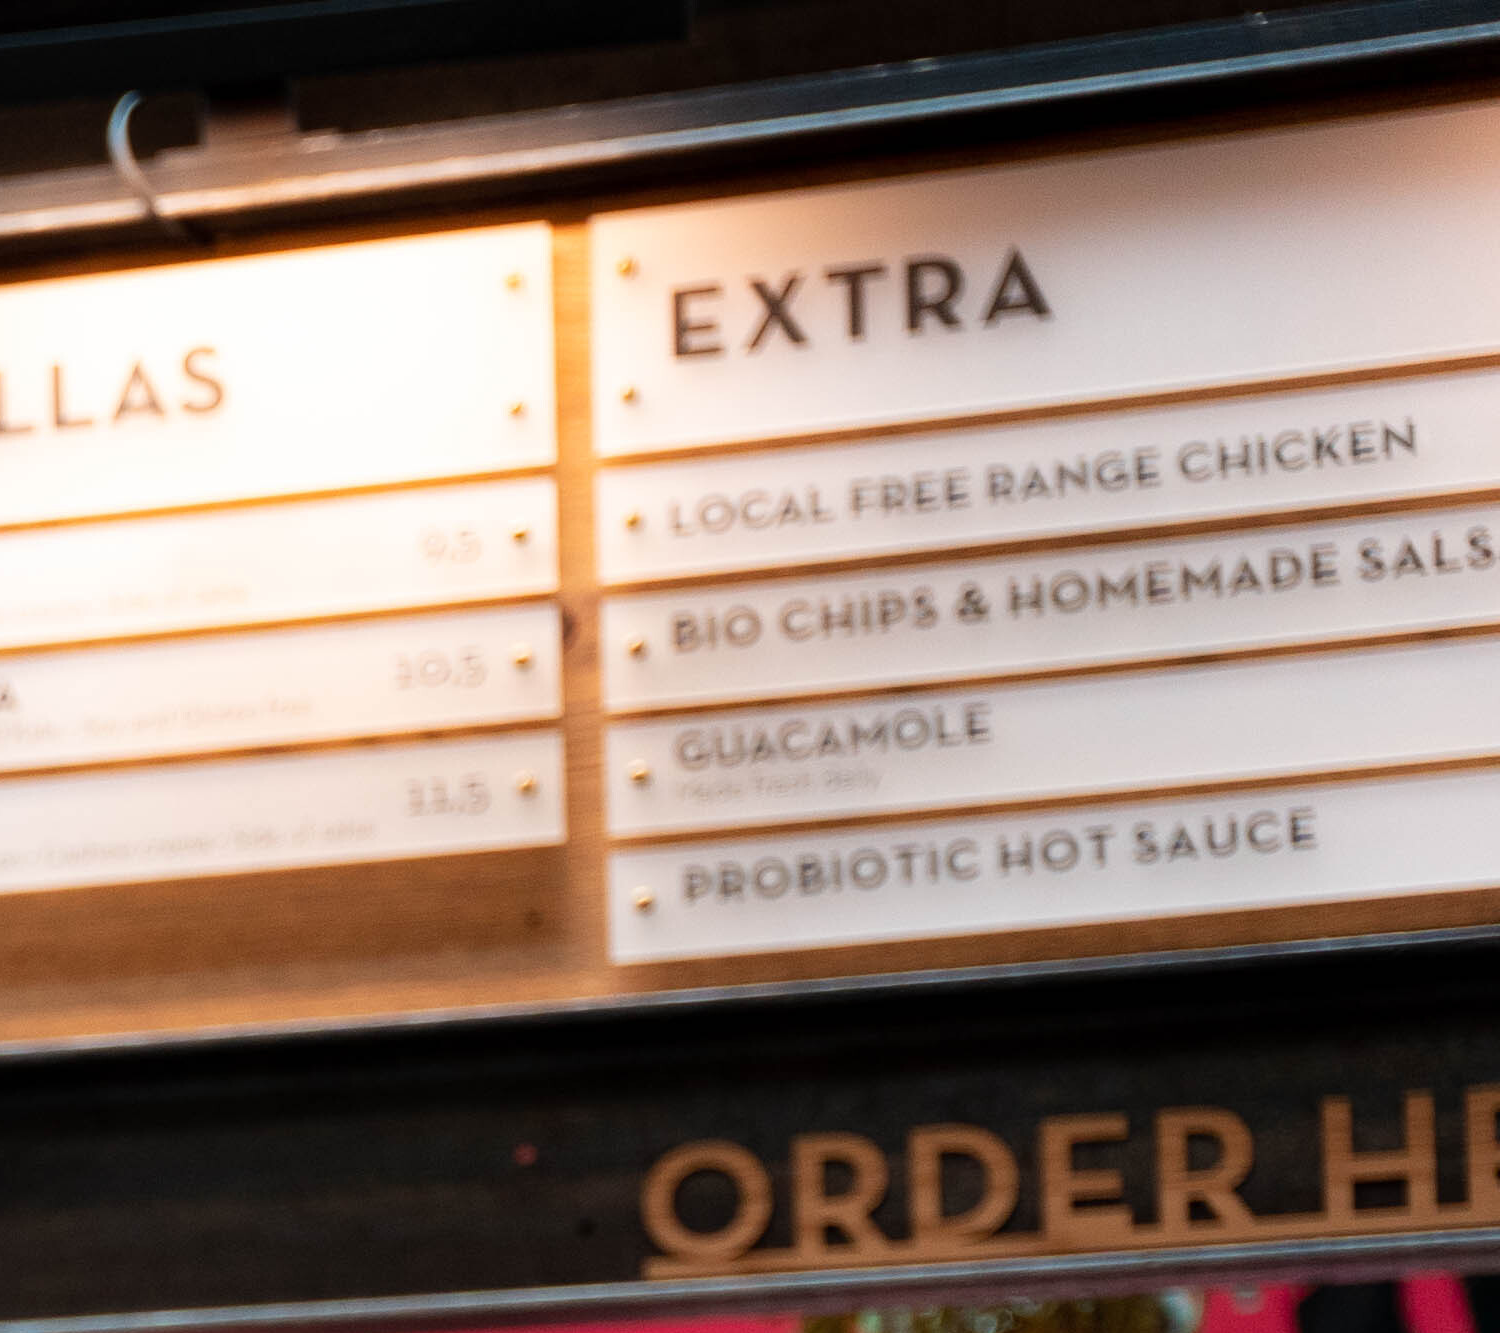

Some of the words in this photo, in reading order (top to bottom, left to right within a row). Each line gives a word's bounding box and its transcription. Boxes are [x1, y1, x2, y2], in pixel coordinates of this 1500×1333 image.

[671, 245, 1052, 360] EXTRA
[670, 484, 834, 536] LOCAL
[851, 465, 971, 519] FREE
[989, 445, 1161, 503] RANGE
[1181, 417, 1417, 484] CHICKEN
[672, 607, 762, 656] BIO
[782, 587, 938, 644] CHIPS
[957, 583, 990, 625] &
[1012, 543, 1338, 619] HOMEMADE
[1357, 526, 1500, 582] SALS
[675, 702, 992, 772] GUACAMOLE
[684, 839, 979, 906] PROBIOTIC
[999, 823, 1118, 878] HOT
[1133, 807, 1316, 863] SAUCE
[642, 1107, 1255, 1262] ORDER
